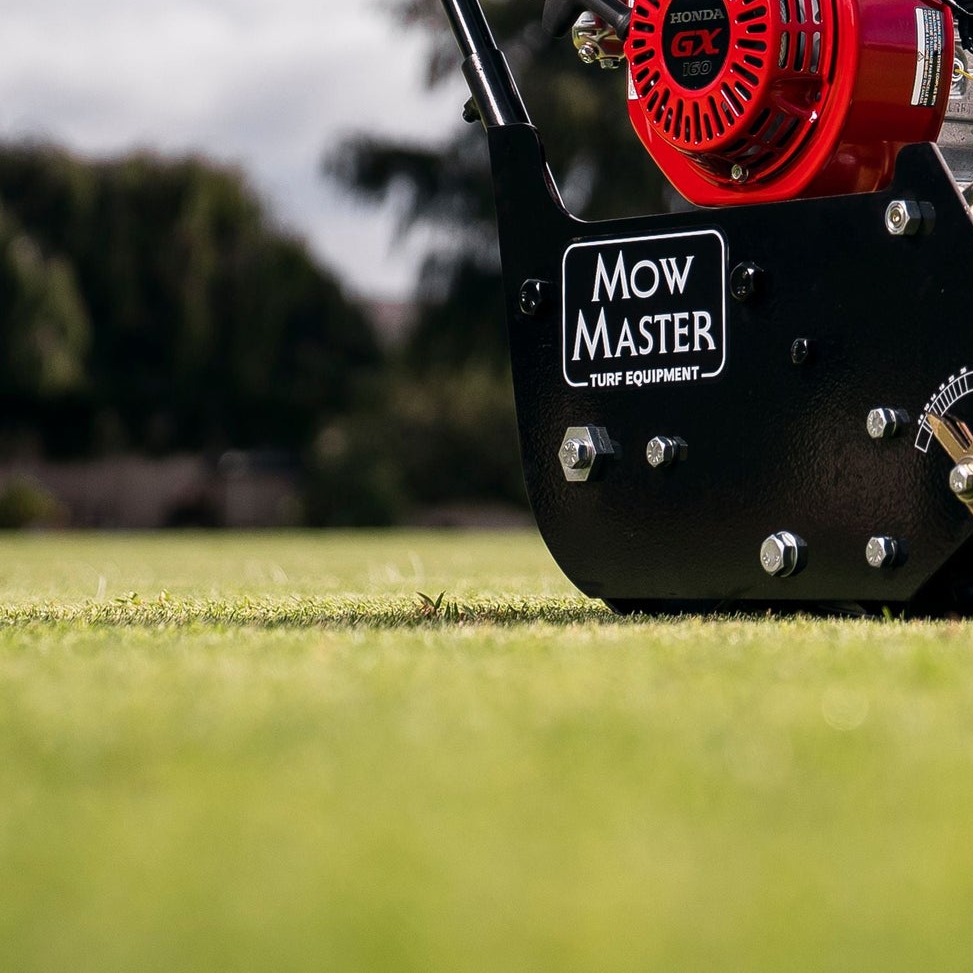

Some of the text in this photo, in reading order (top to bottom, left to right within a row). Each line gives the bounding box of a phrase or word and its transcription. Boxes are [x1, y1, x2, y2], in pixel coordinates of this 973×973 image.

[670, 8, 725, 24] HONDA
[671, 28, 722, 58] GX
[683, 60, 712, 76] 160
[591, 250, 695, 302] MOW
[571, 306, 716, 361] MASTER
[590, 366, 700, 387] TURF EQUIPMENT
